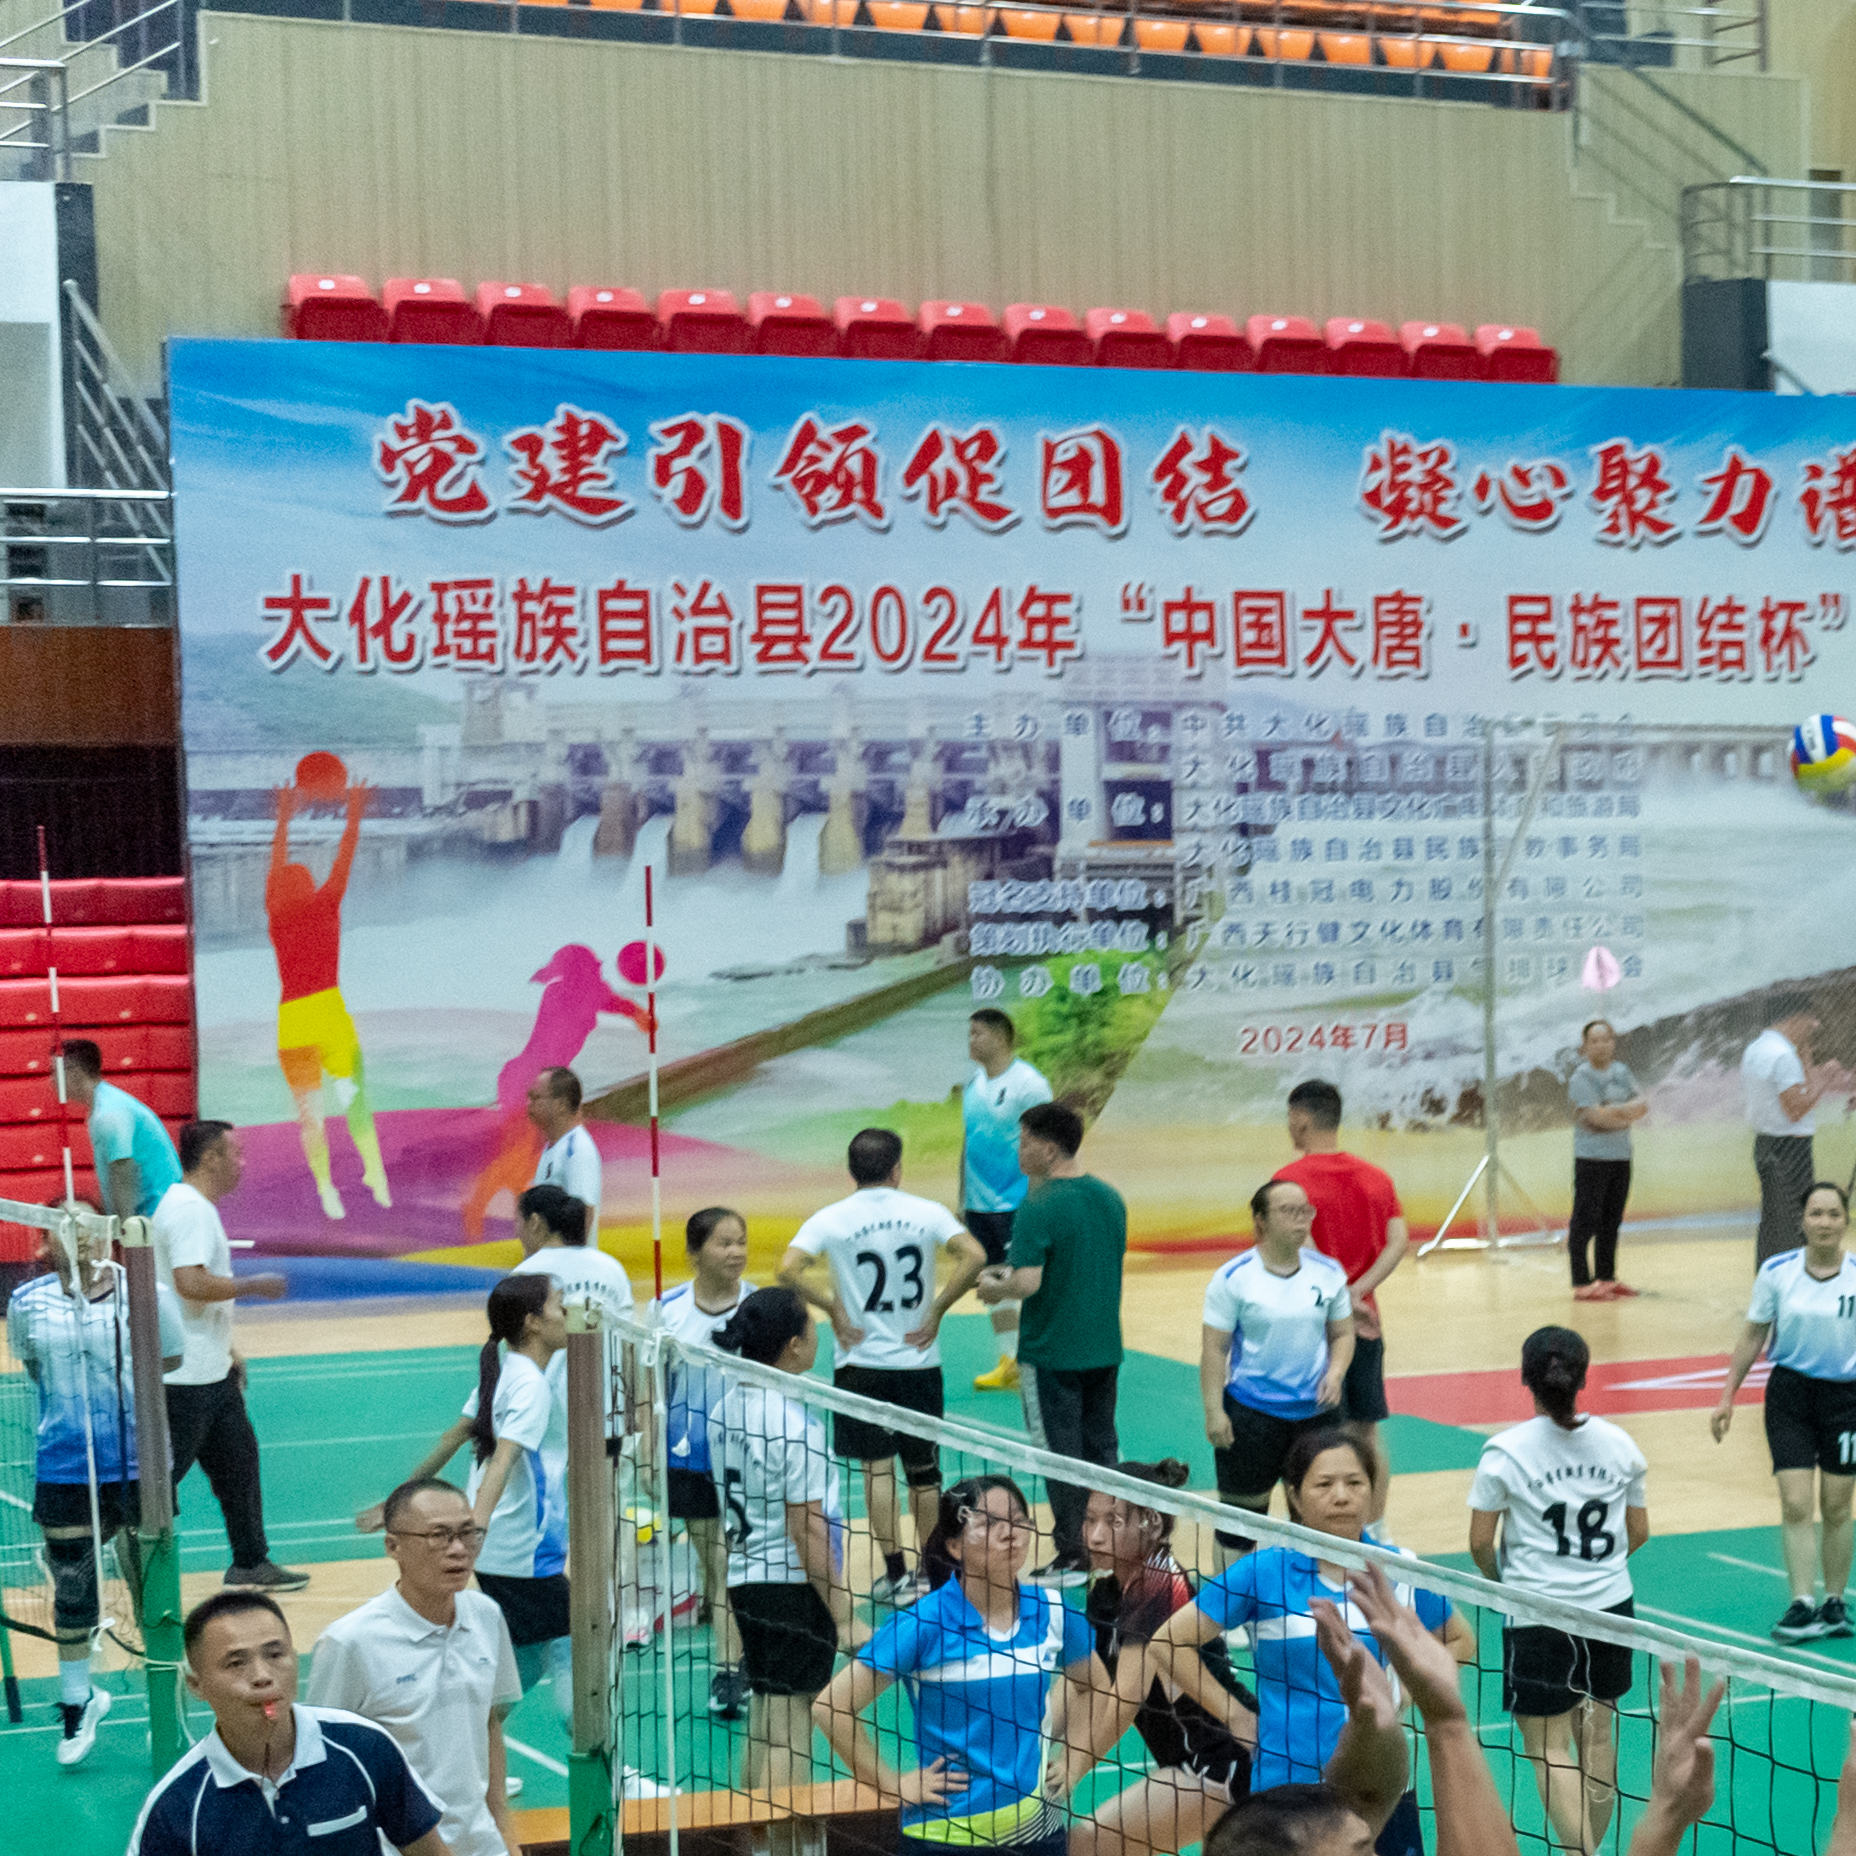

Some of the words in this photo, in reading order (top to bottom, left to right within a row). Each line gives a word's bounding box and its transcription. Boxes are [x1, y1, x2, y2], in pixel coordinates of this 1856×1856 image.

[374, 403, 1252, 529] 党建引领促团结
[1186, 955, 1643, 991] 大化瑶族自治县气排球会
[1240, 1022, 1409, 1053] 2024年7月
[856, 1243, 924, 1314] 23
[1837, 1294, 1856, 1319] 11
[1541, 1498, 1616, 1563] 18
